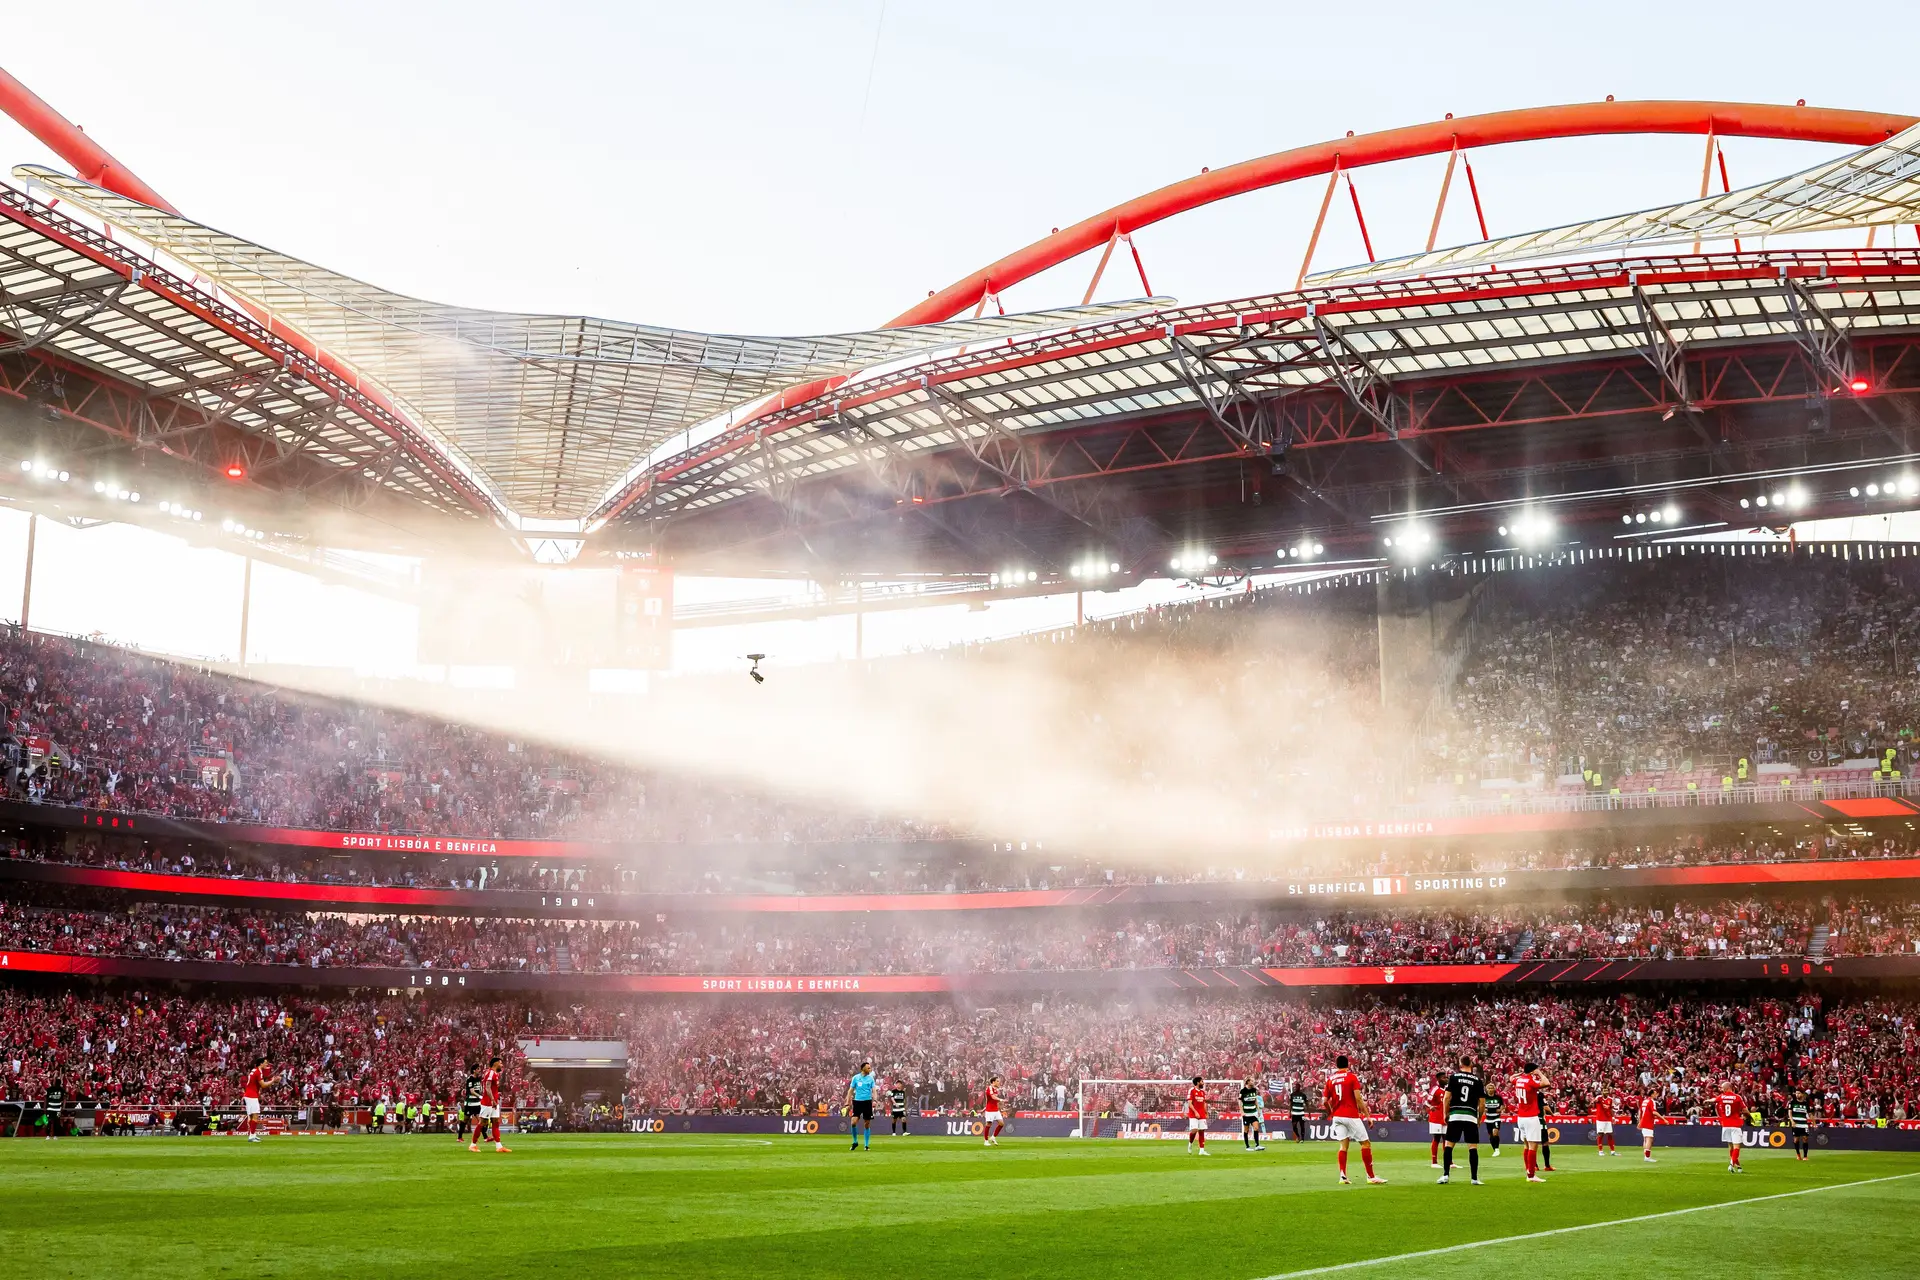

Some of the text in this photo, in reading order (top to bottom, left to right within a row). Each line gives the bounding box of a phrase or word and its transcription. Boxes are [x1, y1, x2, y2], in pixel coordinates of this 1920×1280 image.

[83, 815, 134, 829] 1904
[1365, 825, 1373, 835] E
[342, 836, 497, 852] SPORT LISBOA E BENFICA
[992, 841, 1043, 852] 1904
[1288, 884, 1304, 894] SL
[1309, 882, 1366, 894] BENFICA
[1395, 879, 1402, 893] 1
[1414, 878, 1484, 890] SPORTING
[1489, 877, 1507, 888] CP
[541, 896, 595, 907] 1904
[1762, 963, 1833, 974] 1904
[410, 975, 466, 986] 1904
[702, 979, 860, 989] SPORT LISBOA E BENFICA
[1334, 1083, 1342, 1101] 4
[1460, 1085, 1470, 1102] 9
[1724, 1104, 1732, 1116] 8
[1124, 1131, 1156, 1140] Betano
[1161, 1131, 1190, 1140] Betan
[1742, 1128, 1787, 1148] uto
